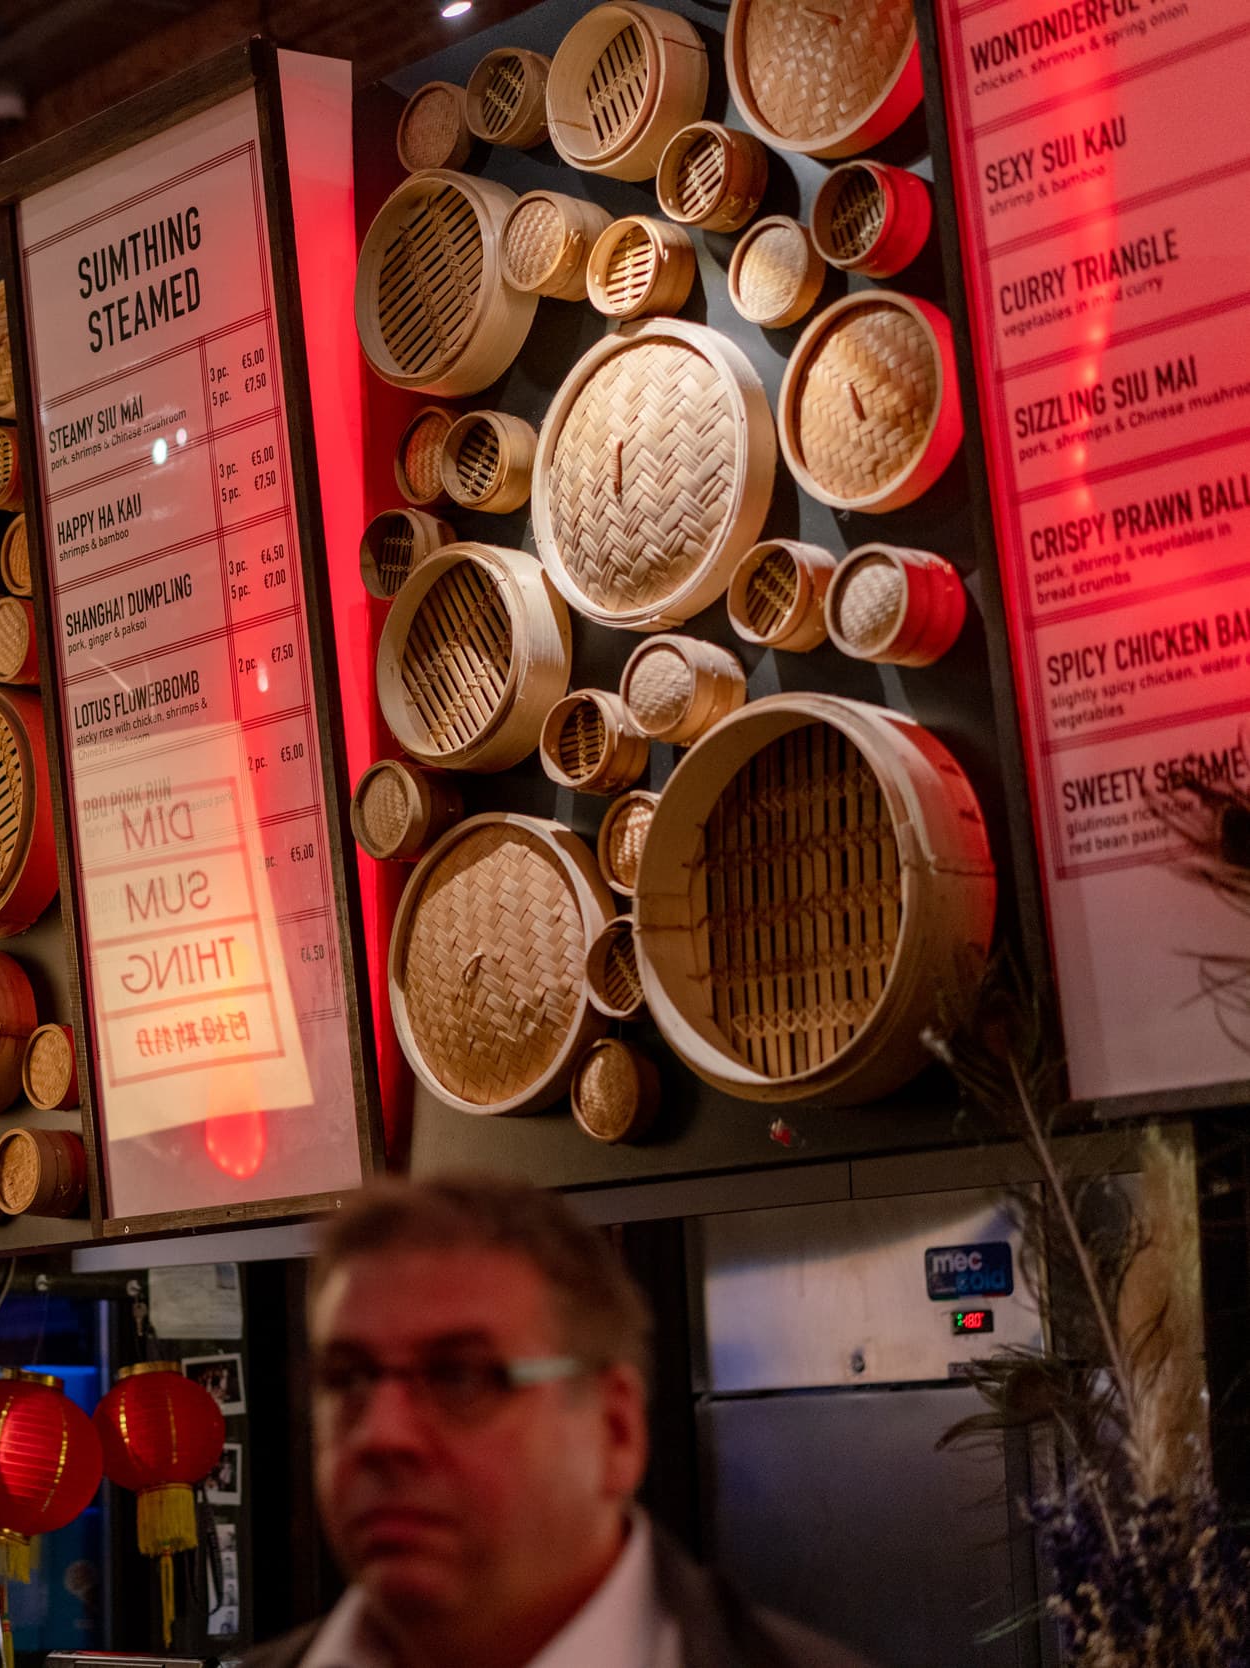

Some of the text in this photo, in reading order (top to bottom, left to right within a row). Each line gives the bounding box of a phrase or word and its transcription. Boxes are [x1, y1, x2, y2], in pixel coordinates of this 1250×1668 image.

[1030, 43, 1086, 75] shrimps
[1089, 35, 1100, 51] &
[1103, 18, 1147, 48] spring
[1150, 2, 1190, 27] onion
[985, 115, 1127, 195] SEXY SUI KAU
[77, 206, 202, 300] SUMTHING
[999, 227, 1179, 316] CURRY TRIANGLE
[88, 267, 201, 353] STEAMED
[210, 348, 265, 384] 3 pc. €5.00
[212, 372, 266, 408] 5 pc. €7.50
[1014, 354, 1198, 439] SIZZLING SIU MAI
[49, 394, 144, 453] STEAMY SIU MAI
[71, 442, 101, 463] shrimps
[104, 440, 110, 450] &
[111, 426, 142, 446] Chinese
[144, 409, 187, 432] mushroom
[219, 445, 275, 480] 3 pc. €5.00
[222, 470, 276, 504] 5 pc. €7.50
[57, 492, 142, 546] HAPPY HA KAU
[1030, 512, 1106, 563] CRISPY
[1112, 488, 1194, 542] PRAWN
[59, 528, 129, 562] shrimps & bamboo
[229, 544, 285, 577] 3 pc. €4.50
[66, 573, 192, 637] SHANGHAI DUMPLING
[231, 569, 287, 601] 5 pc. €7.00
[89, 631, 112, 650] ginger
[114, 626, 120, 638] &
[122, 617, 147, 641] paksoi
[1047, 643, 1107, 687] SPICY
[1114, 618, 1210, 671] CHICKEN
[238, 643, 294, 675] 2 pc. €7.50
[74, 670, 200, 730] LOTUS FLOWERBOMB
[76, 731, 97, 746] sticky
[100, 726, 113, 739] rice
[115, 720, 131, 734] with
[166, 702, 199, 720] shrimps
[201, 697, 208, 709] &
[255, 757, 268, 773] pc.
[280, 743, 304, 762] €5.00
[1062, 766, 1147, 813] SWEETY
[290, 843, 314, 862] €5.00
[932, 1252, 983, 1273] mec
